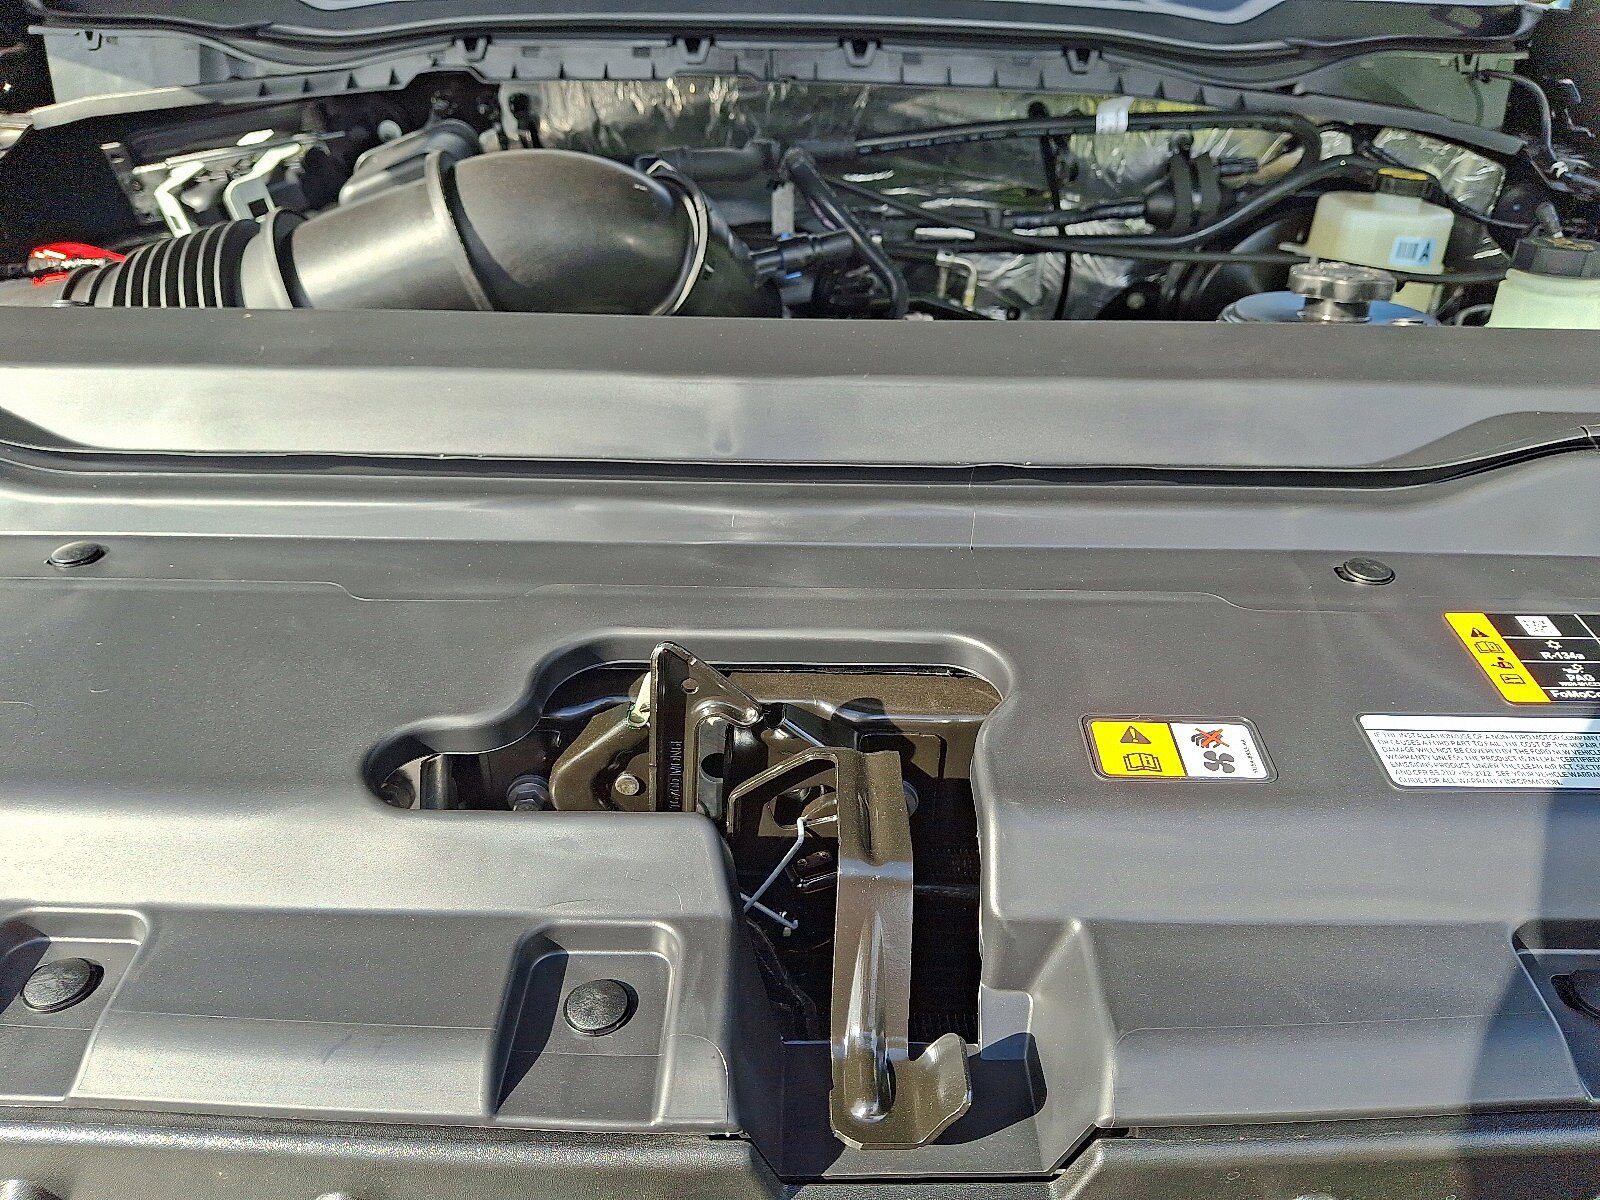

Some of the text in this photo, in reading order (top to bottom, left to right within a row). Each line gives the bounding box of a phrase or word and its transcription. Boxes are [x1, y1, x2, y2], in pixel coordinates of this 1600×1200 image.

[1418, 242, 1430, 258] A
[1539, 651, 1586, 660] R-134a
[1565, 673, 1596, 682] PAG
